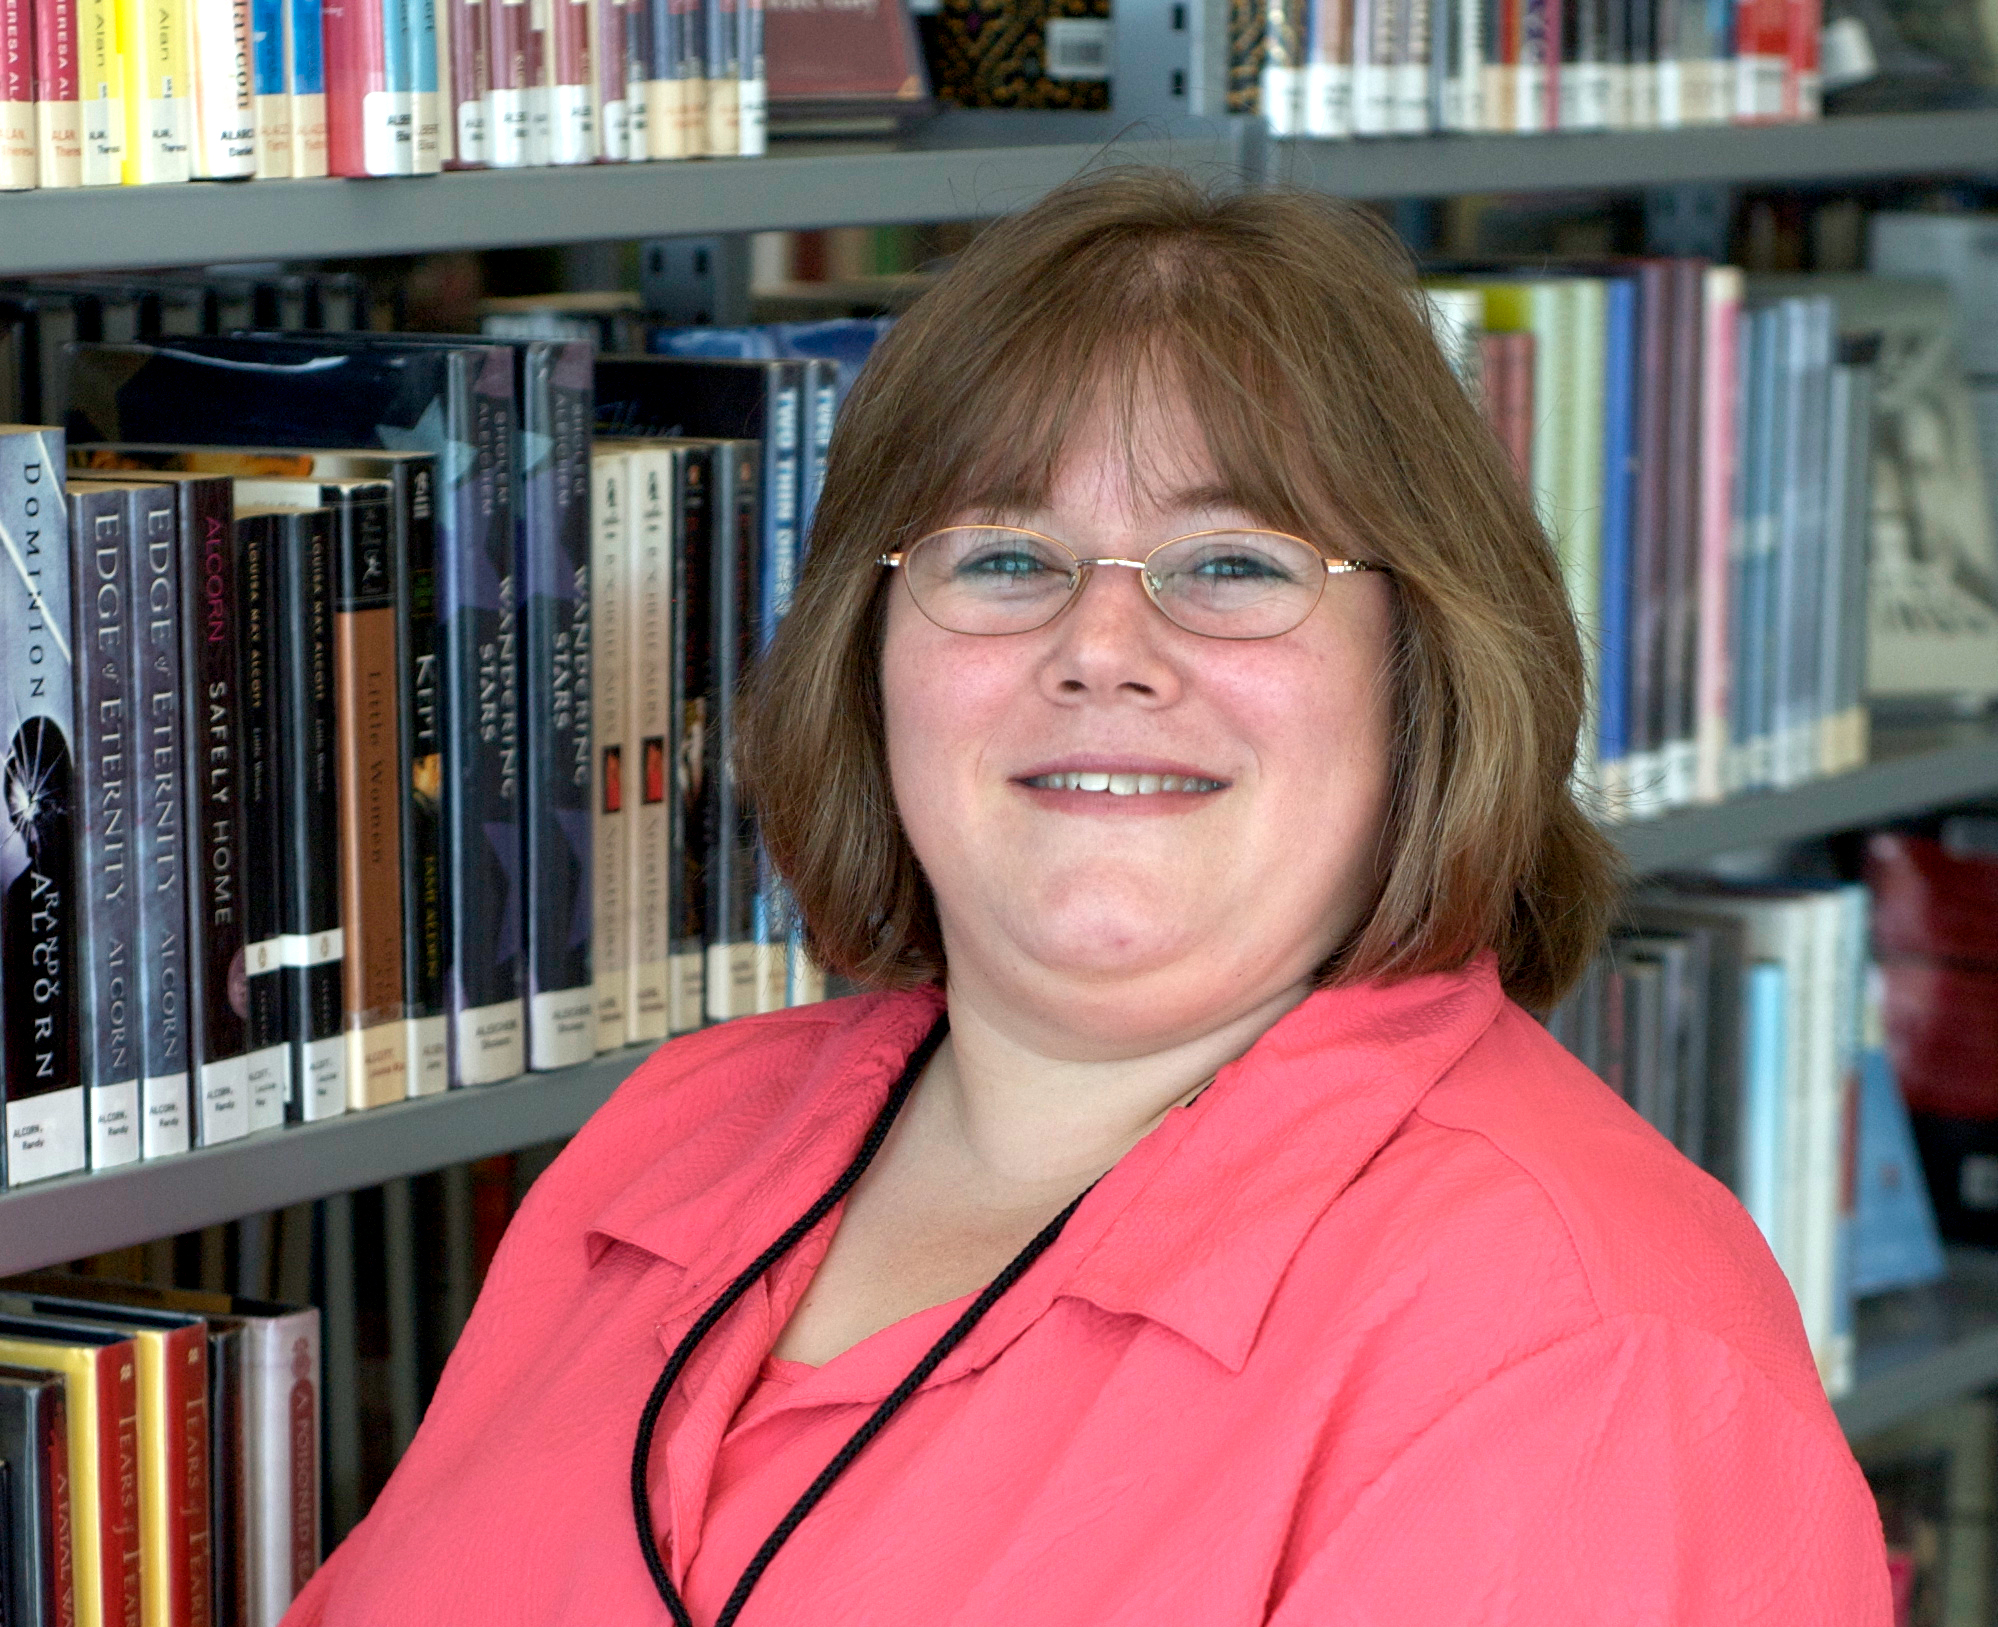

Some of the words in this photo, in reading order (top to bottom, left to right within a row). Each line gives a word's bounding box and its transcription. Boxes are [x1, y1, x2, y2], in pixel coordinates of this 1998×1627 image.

[94, 14, 106, 68] Alan
[157, 8, 170, 62] Alan
[23, 462, 45, 698] DOMINION
[95, 513, 120, 651] EDGE
[148, 508, 172, 644] EDGE
[205, 516, 225, 643] ALCORN
[248, 541, 261, 602] LOUISA
[311, 534, 323, 595] LOUISA
[250, 608, 262, 643] MAY
[313, 600, 325, 636] MAY
[250, 649, 263, 709] ALCOTT
[314, 641, 326, 701] ALCOTT
[368, 671, 384, 747] Little
[479, 643, 498, 743] STARS
[498, 575, 517, 799] WANDERING
[553, 632, 571, 731] STARS
[572, 564, 590, 787] WANDERING
[152, 690, 176, 894] ETERNITY
[208, 680, 230, 804] SAFELY
[101, 698, 125, 902] ETERNITY
[369, 760, 384, 865] Women
[212, 820, 233, 926] HOME
[30, 871, 54, 1079] ALCORN
[44, 891, 61, 997] RANDY
[108, 936, 127, 1069] ALCORN
[160, 930, 179, 1059] ALCORN
[22, 1138, 45, 1151] Randy
[107, 1125, 129, 1136] Randy
[159, 1116, 180, 1128] Randy
[119, 1414, 137, 1509] TEARS
[186, 1397, 206, 1487] TEARS
[296, 1416, 310, 1542] POISONED
[58, 1500, 72, 1582] FATAL
